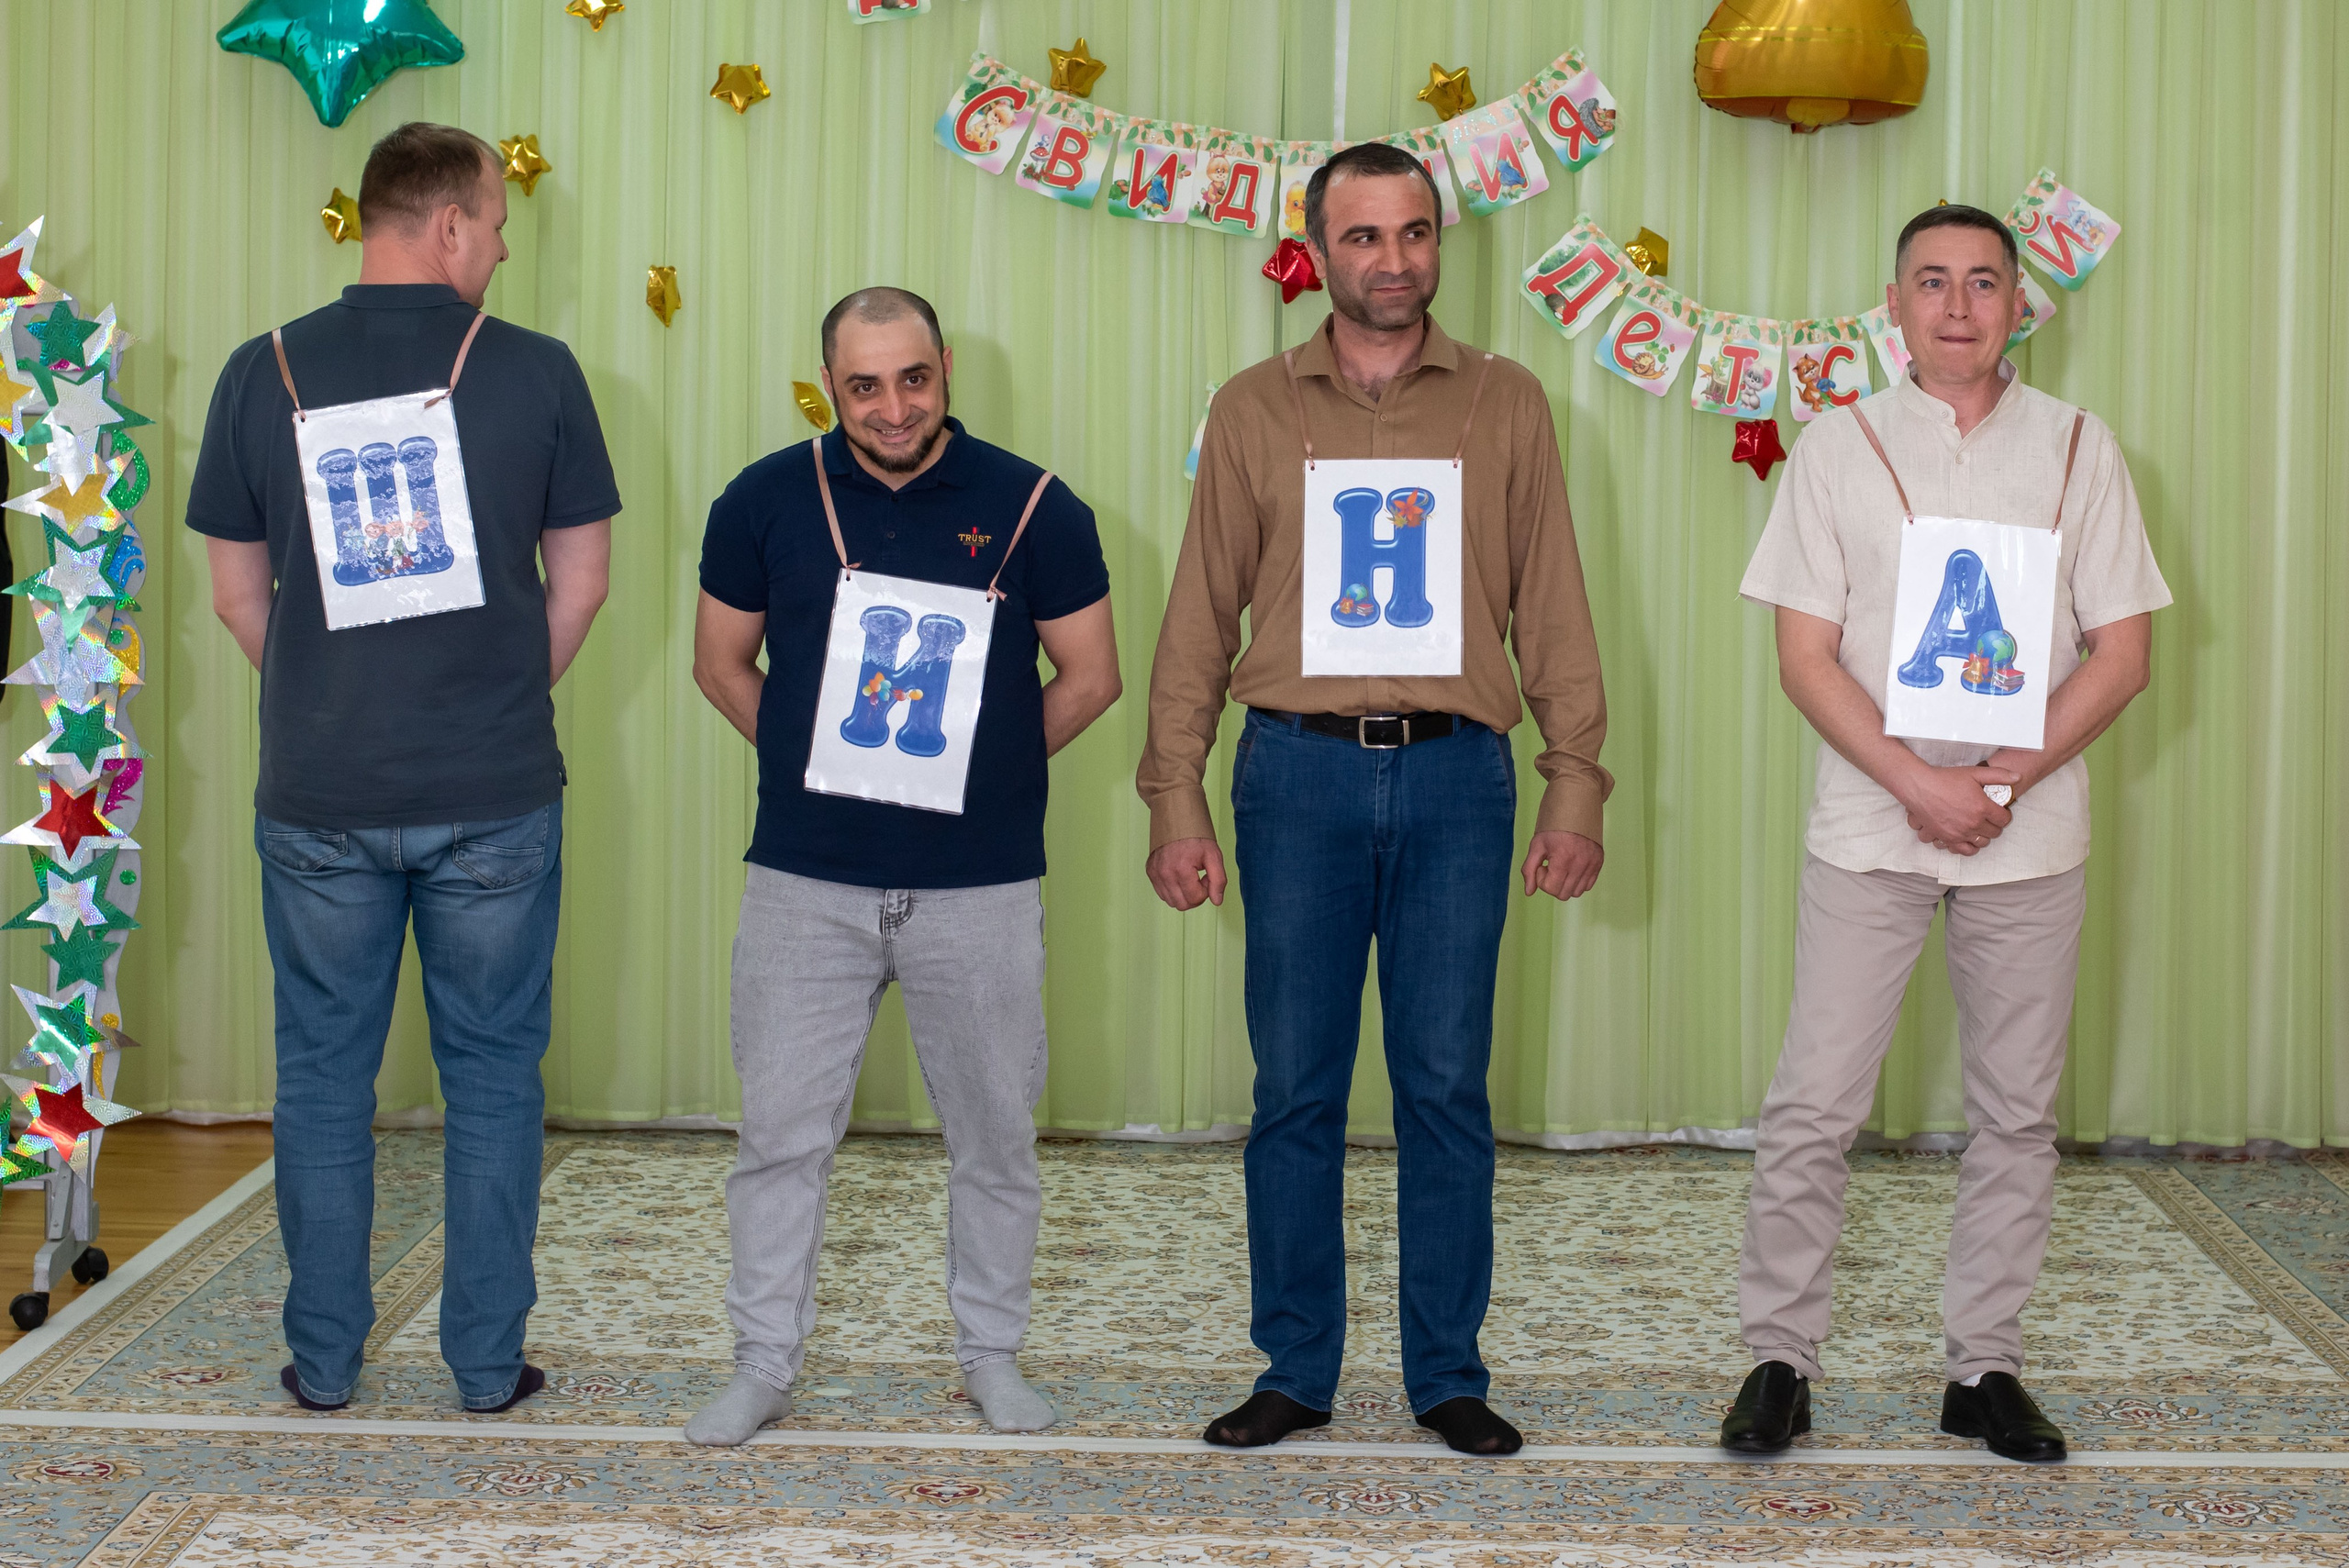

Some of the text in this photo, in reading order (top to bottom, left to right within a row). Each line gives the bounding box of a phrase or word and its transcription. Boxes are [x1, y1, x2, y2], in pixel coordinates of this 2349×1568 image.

[317, 436, 454, 586] Ш
[958, 533, 991, 543] TRUST
[1330, 487, 1435, 628] Н
[840, 606, 966, 757] И
[1898, 549, 2025, 695] А
